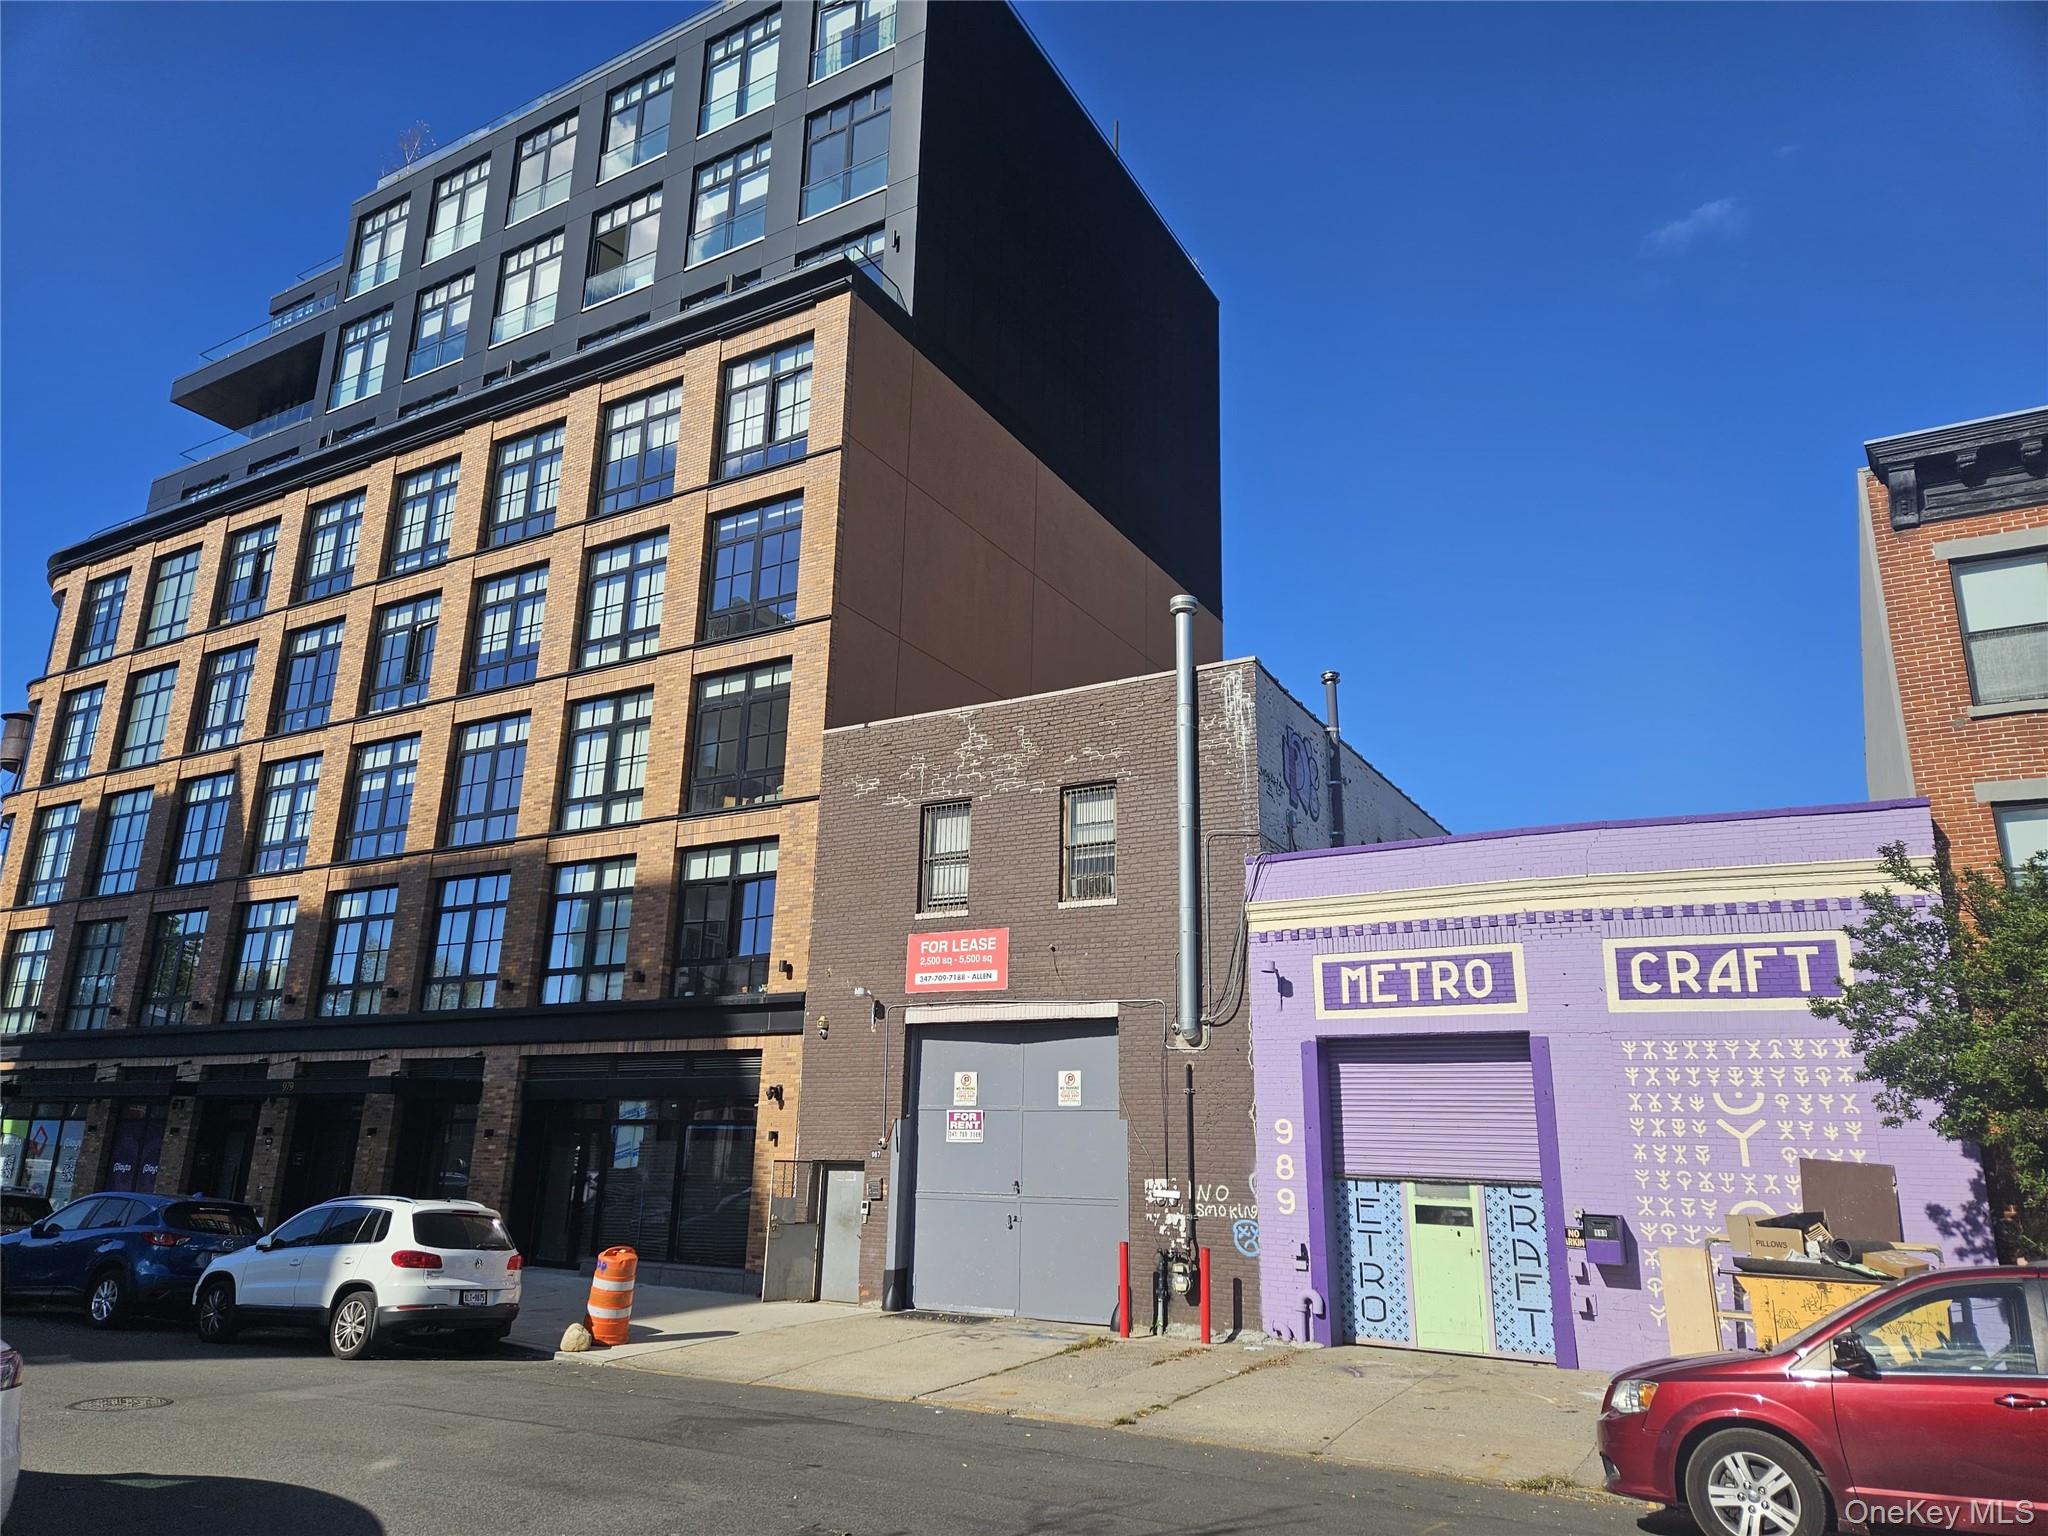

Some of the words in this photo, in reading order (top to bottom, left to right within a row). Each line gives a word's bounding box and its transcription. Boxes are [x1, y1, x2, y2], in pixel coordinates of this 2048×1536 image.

[921, 941, 948, 954] FOR
[952, 937, 997, 952] LEASE
[920, 956, 941, 967] 2,500
[942, 957, 953, 967] sq
[959, 954, 981, 964] 5,500
[982, 955, 993, 964] sq
[1631, 946, 1820, 993] CRAFT
[972, 972, 992, 980] ALLEN
[1340, 959, 1493, 1004] METRO
[954, 1112, 977, 1121] FOR
[950, 1121, 981, 1130] RENT
[1196, 1184, 1229, 1201] NO
[1567, 1229, 1580, 1238] NO
[1755, 1239, 1788, 1249] PILLOWS
